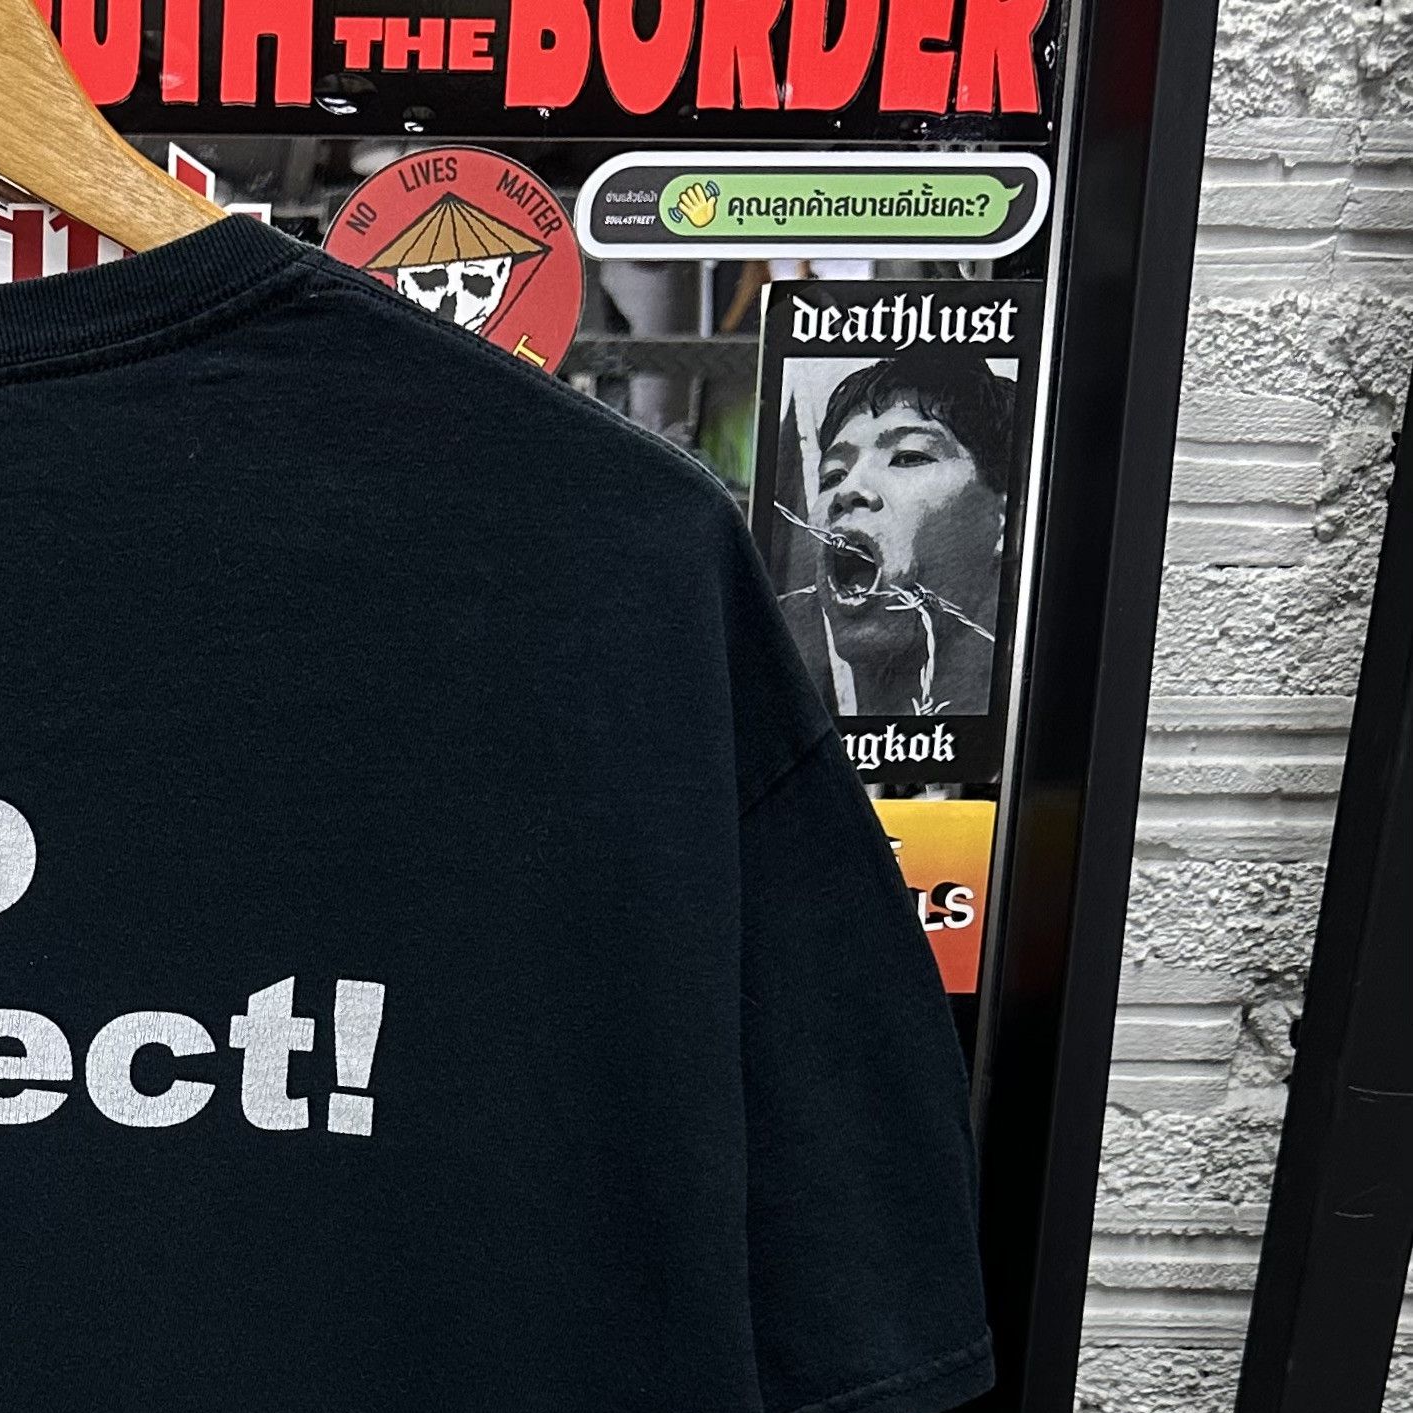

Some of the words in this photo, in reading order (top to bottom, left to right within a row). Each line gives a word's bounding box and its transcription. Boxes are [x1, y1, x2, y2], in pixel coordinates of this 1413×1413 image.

[334, 17, 497, 72] THE
[345, 201, 378, 236] NO
[397, 156, 458, 193] LIVES
[495, 168, 563, 239] MATTER
[727, 182, 991, 226] คุณลูกค้าสบายดีมั้ยคะ?
[791, 294, 1018, 351] deathlust
